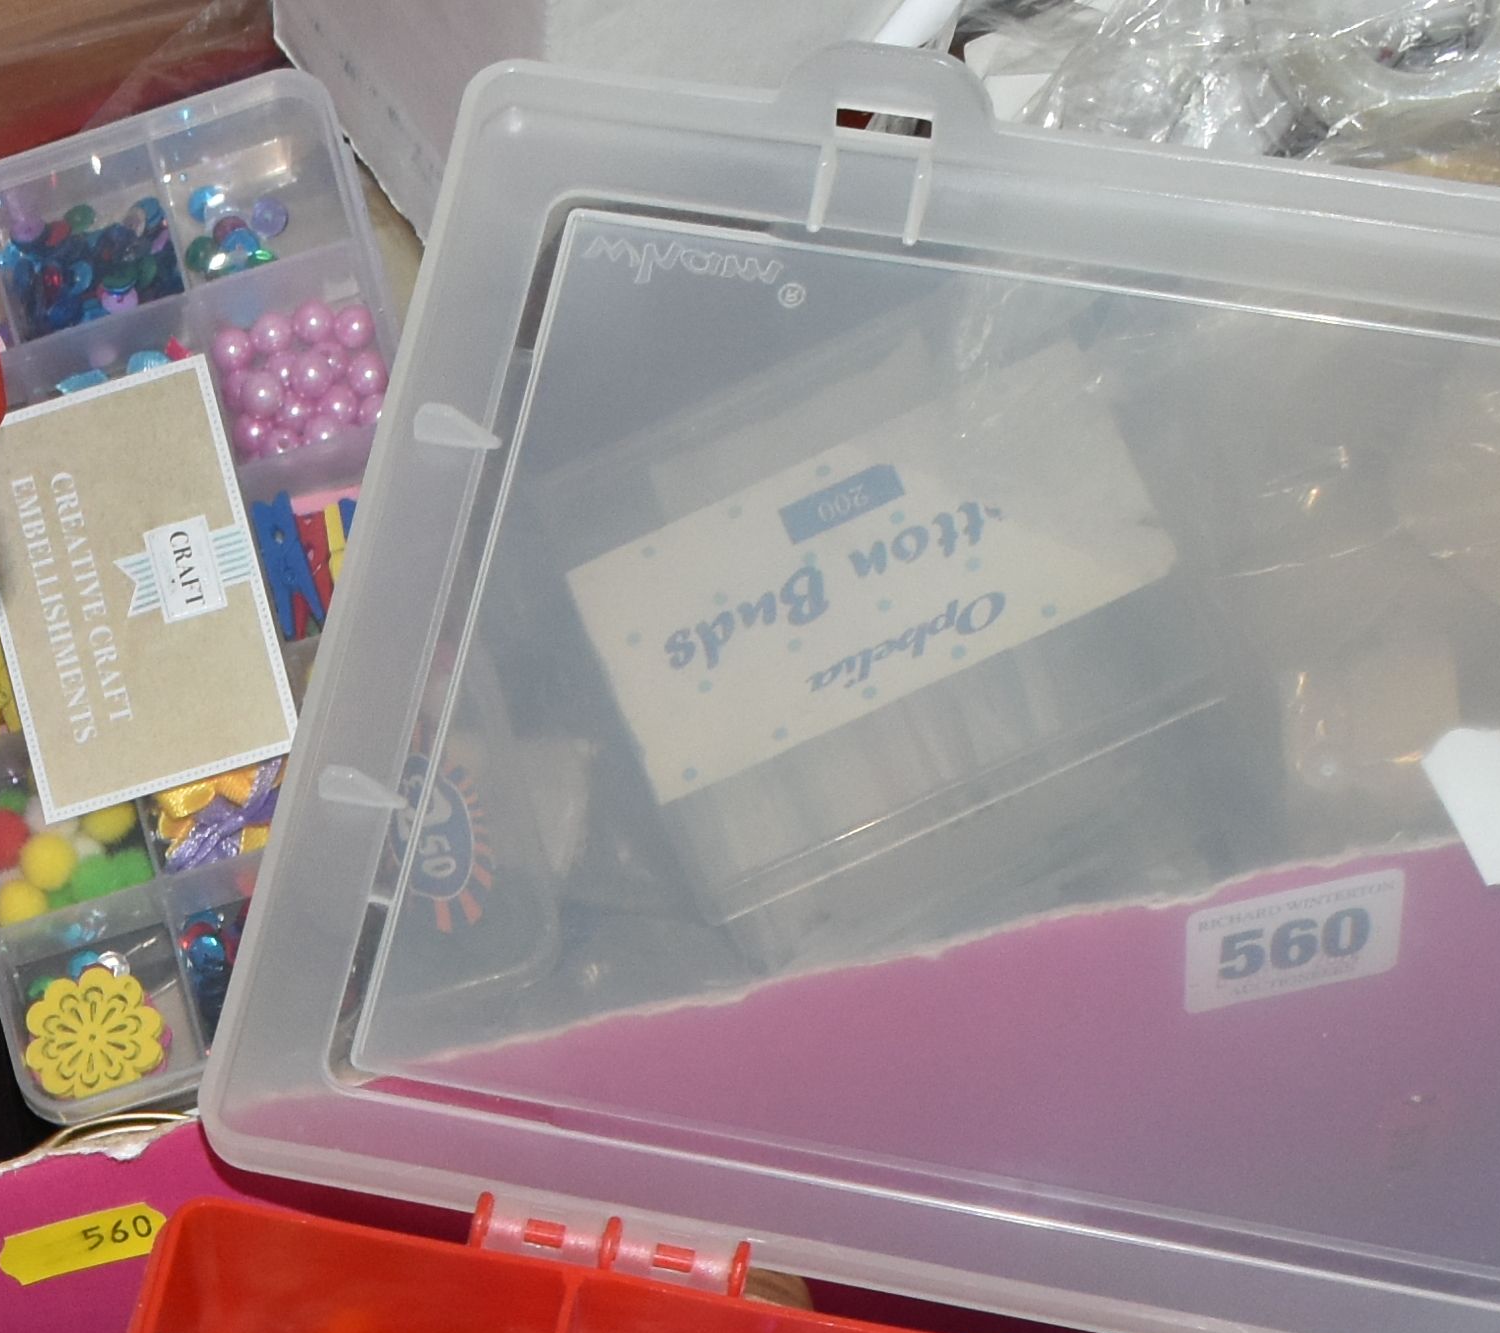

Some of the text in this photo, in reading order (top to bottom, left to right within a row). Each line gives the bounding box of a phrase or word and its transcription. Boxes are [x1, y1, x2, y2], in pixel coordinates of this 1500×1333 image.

[818, 484, 870, 523] 200
[51, 471, 134, 722] CREATIVE CRAFT
[169, 530, 206, 606] CRAFT
[663, 500, 999, 670] tton Buds
[11, 475, 97, 744] EMBELLISHMENTS
[1198, 880, 1397, 932] RICHARD WINTERTON
[1218, 907, 1370, 980] 560
[81, 1214, 152, 1251] 560
